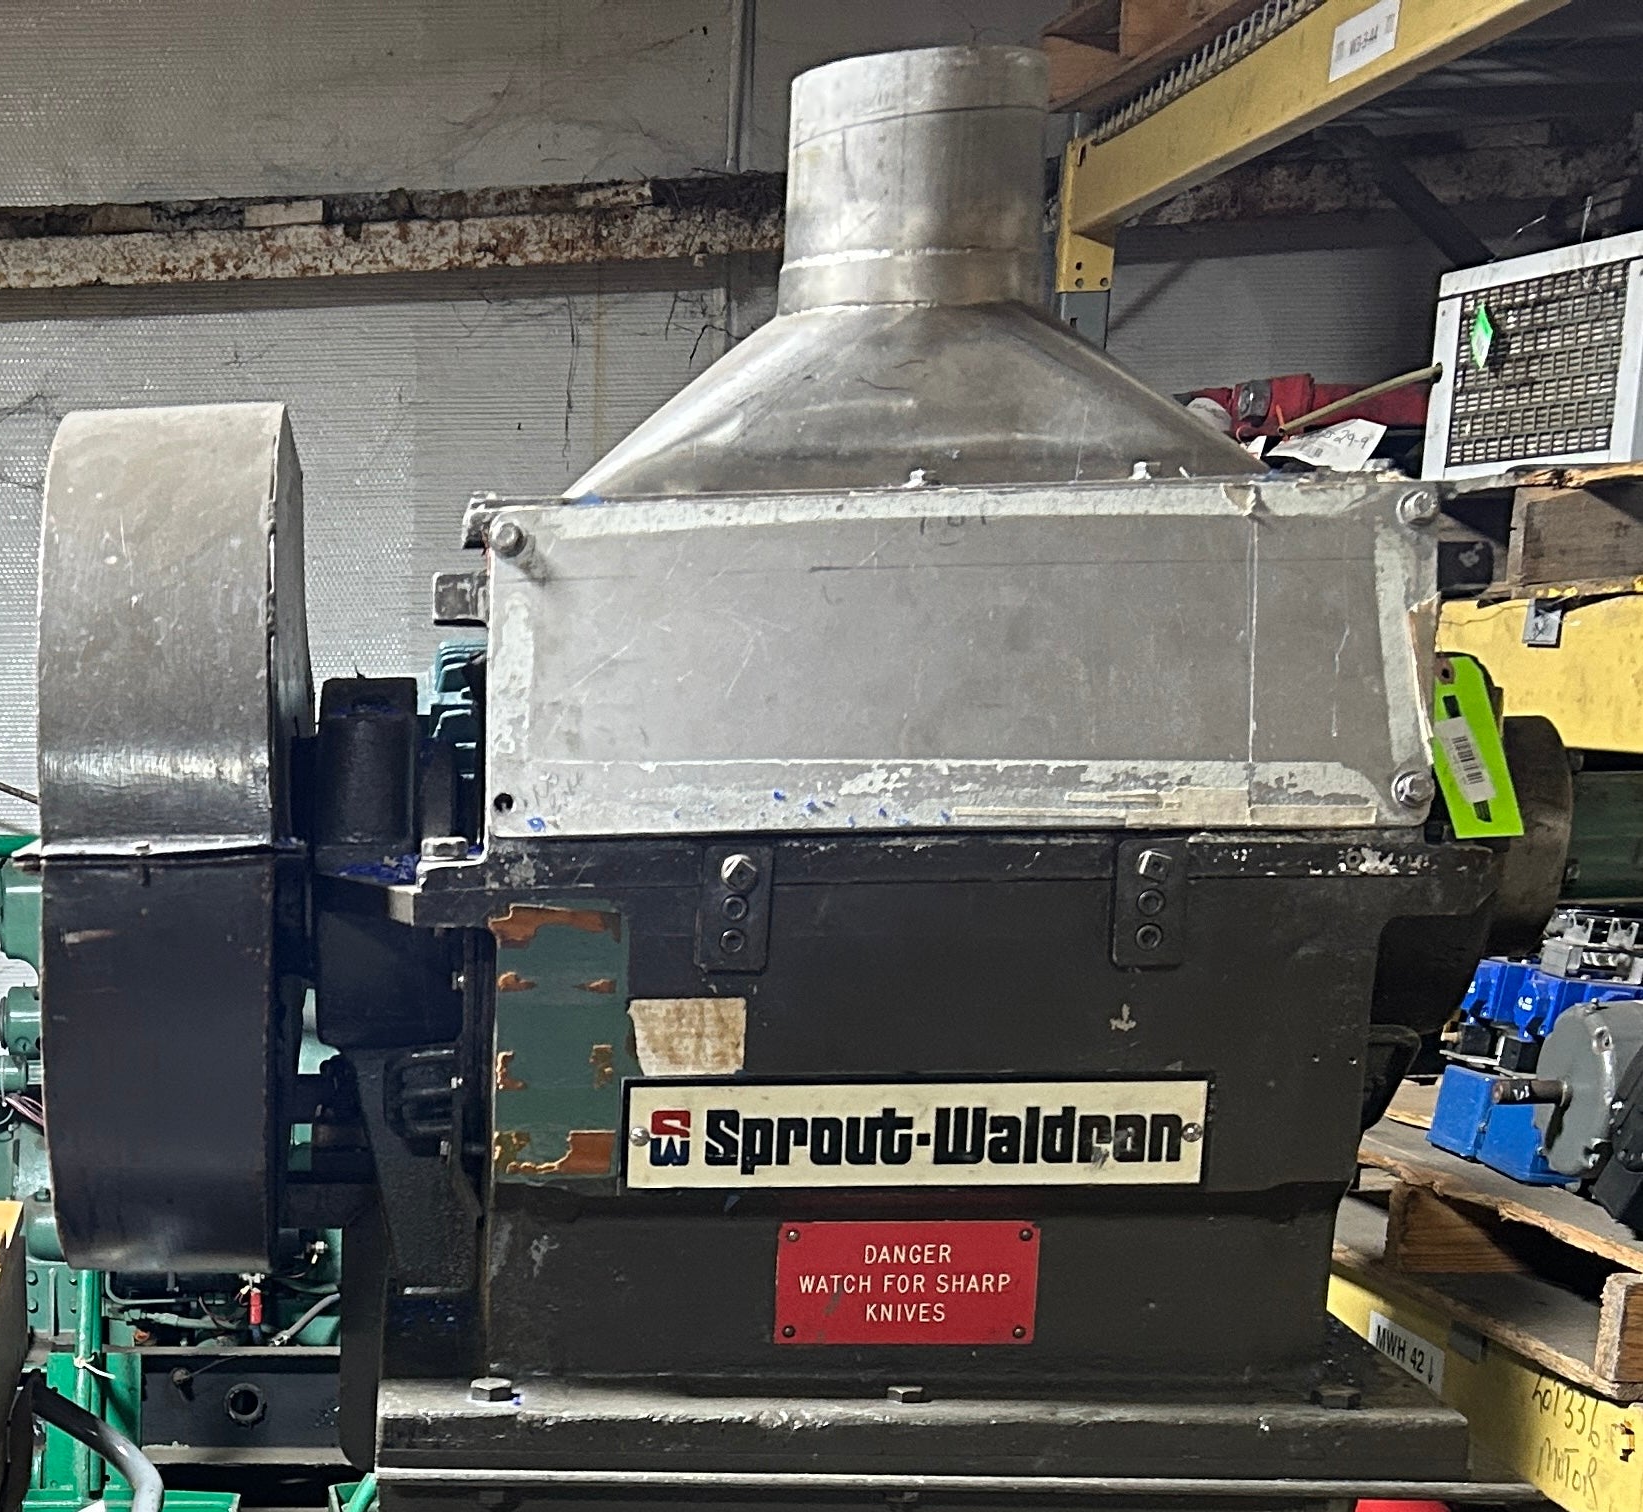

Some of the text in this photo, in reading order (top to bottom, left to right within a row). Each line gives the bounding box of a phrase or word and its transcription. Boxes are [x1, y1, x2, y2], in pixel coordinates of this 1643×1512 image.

[864, 1244, 952, 1265] DANGER
[799, 1273, 1012, 1295] WATCH FOR SHARP
[865, 1303, 946, 1324] KNIVES
[1376, 1324, 1424, 1374] MWH 42
